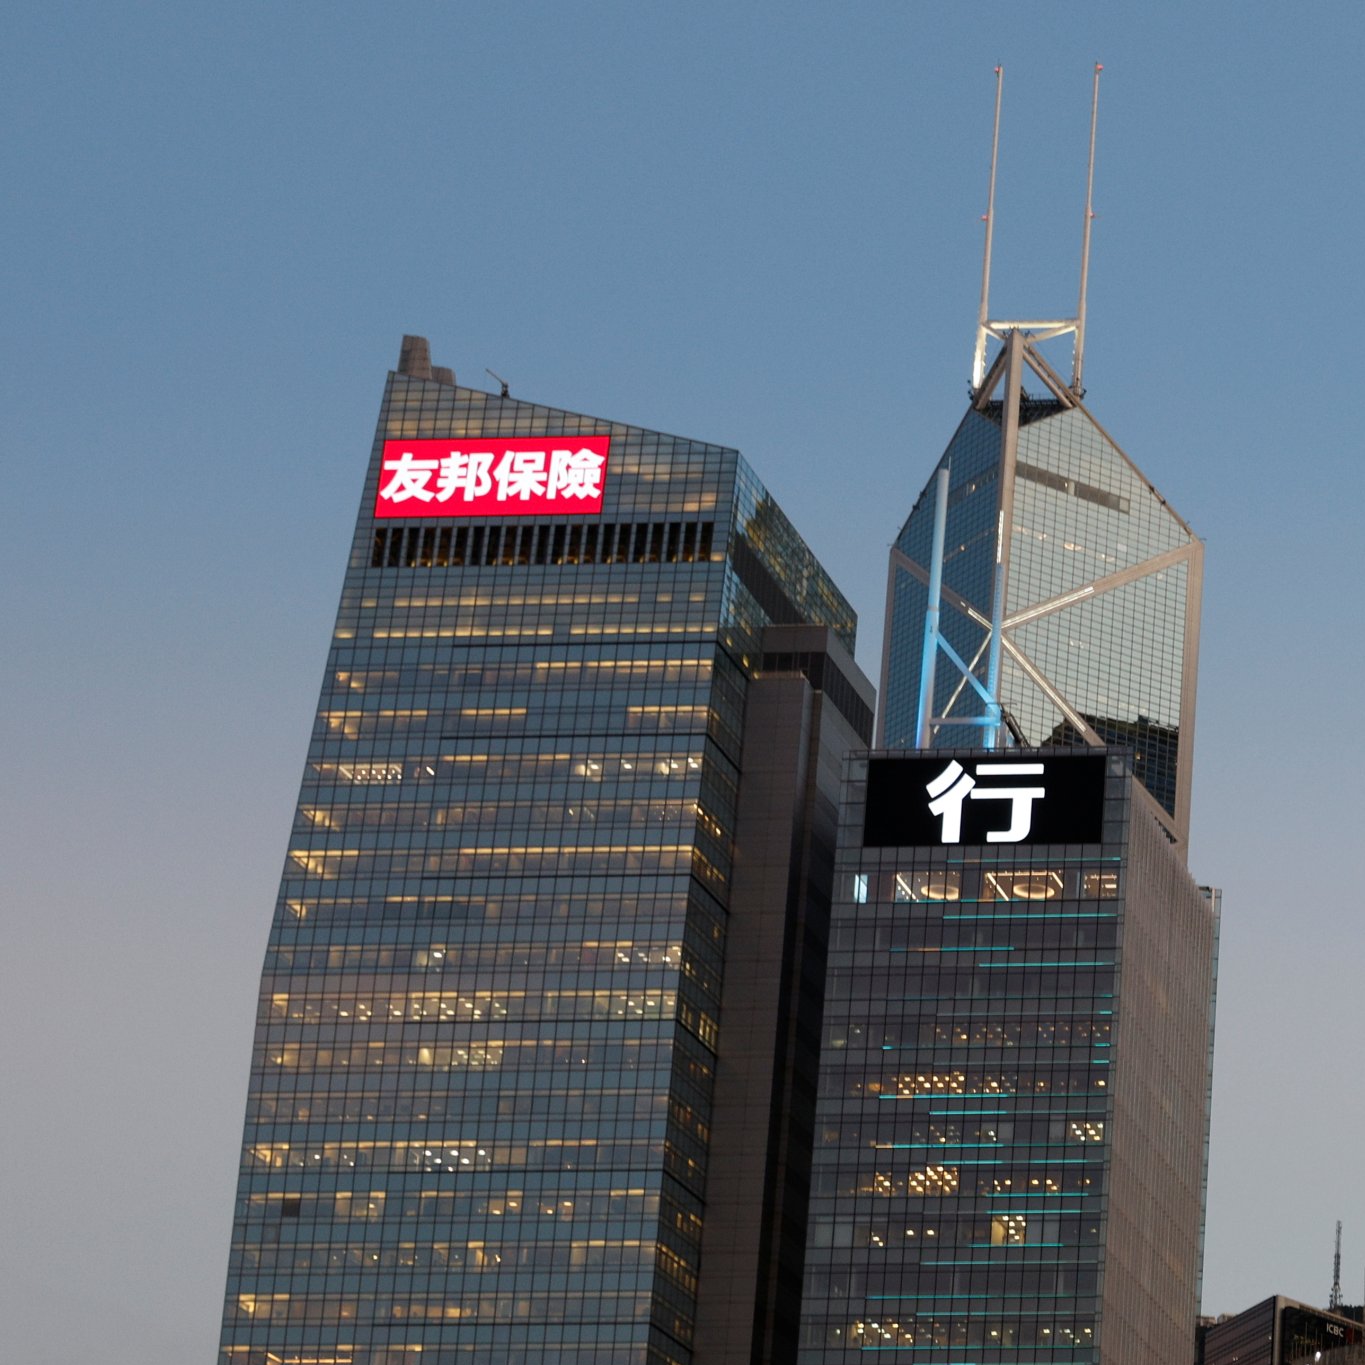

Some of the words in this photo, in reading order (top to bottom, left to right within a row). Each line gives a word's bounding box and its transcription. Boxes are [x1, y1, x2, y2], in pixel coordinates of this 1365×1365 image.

[380, 447, 605, 503] 友邦保險
[926, 760, 1045, 843] 行
[1326, 1322, 1345, 1338] ICBC
